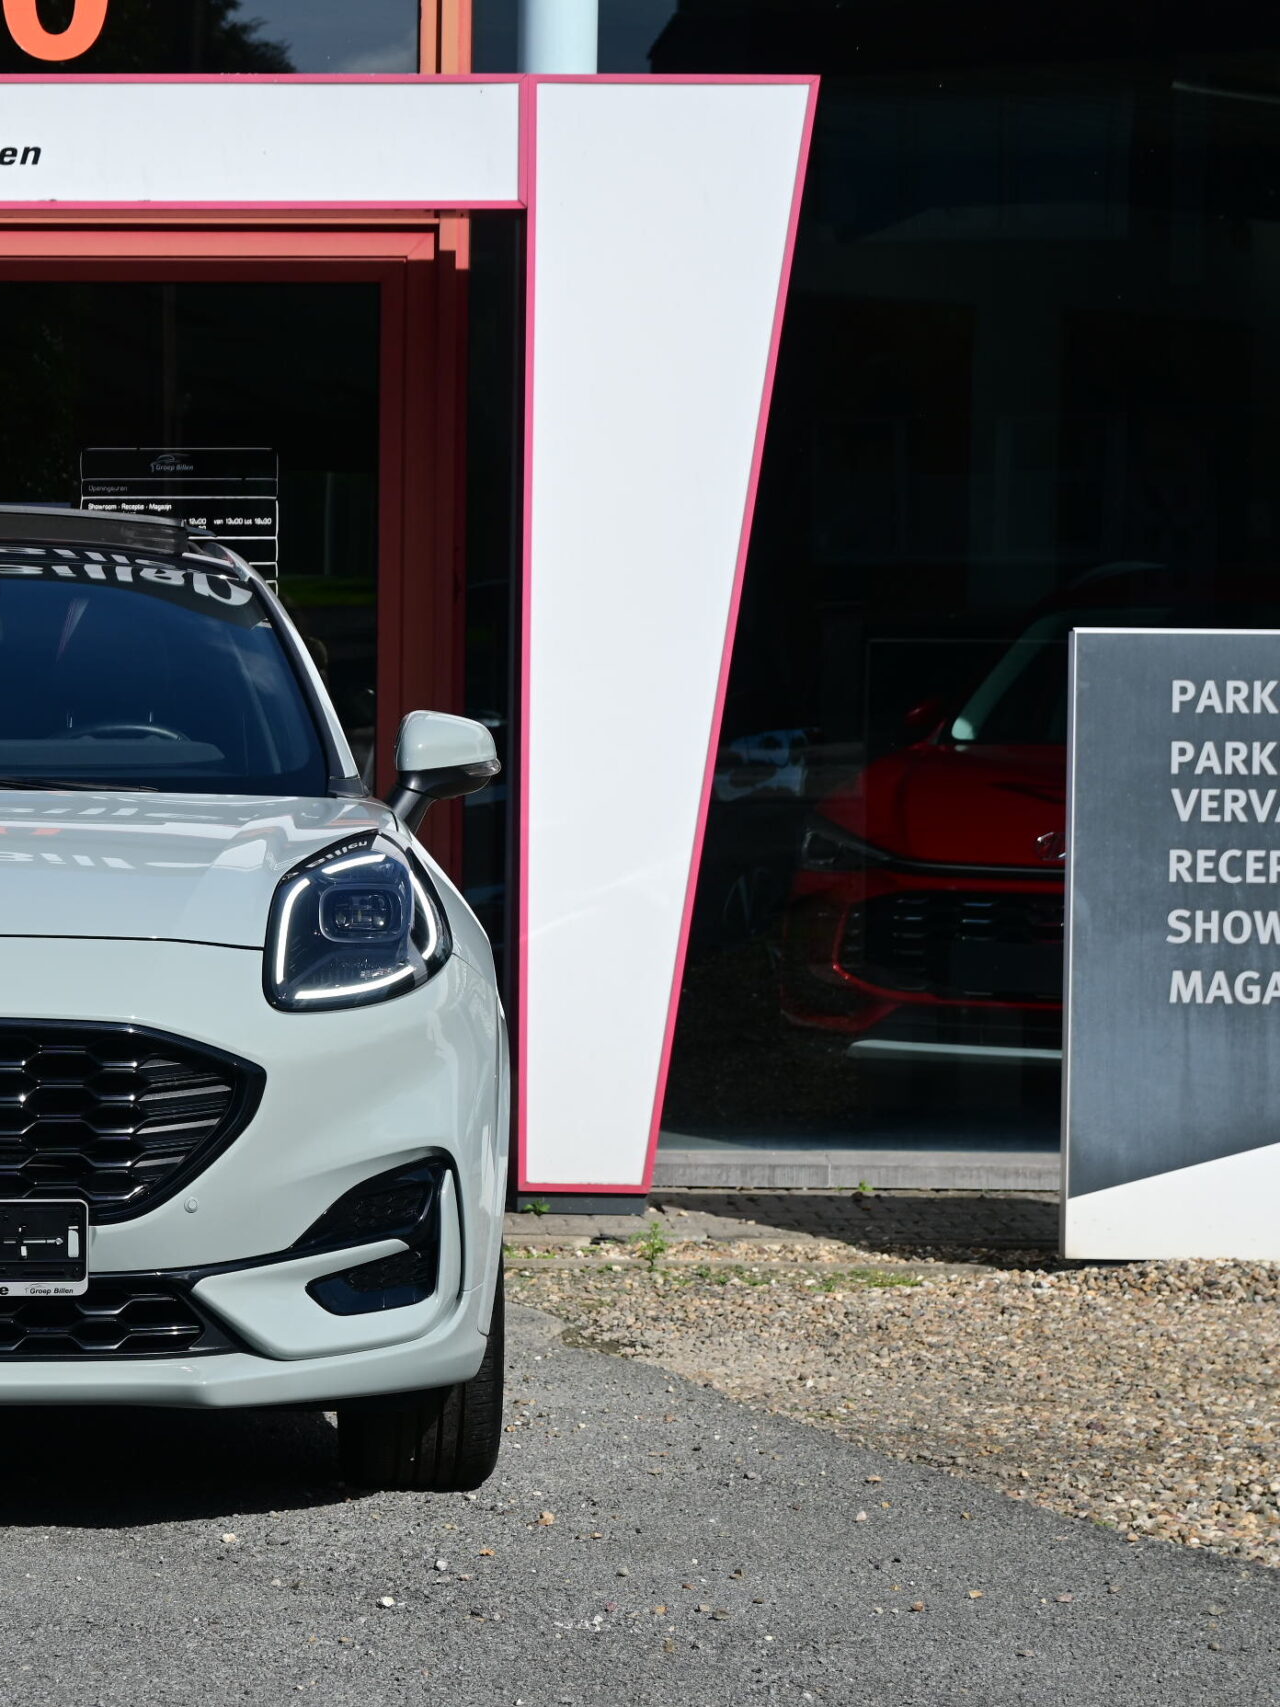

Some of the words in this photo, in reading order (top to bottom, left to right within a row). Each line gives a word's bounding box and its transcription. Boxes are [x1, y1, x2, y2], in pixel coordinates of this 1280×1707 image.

[88, 503, 117, 511] Showroom
[121, 503, 144, 511] Receptie
[1171, 680, 1279, 714] PARK
[1170, 741, 1278, 775] PARK
